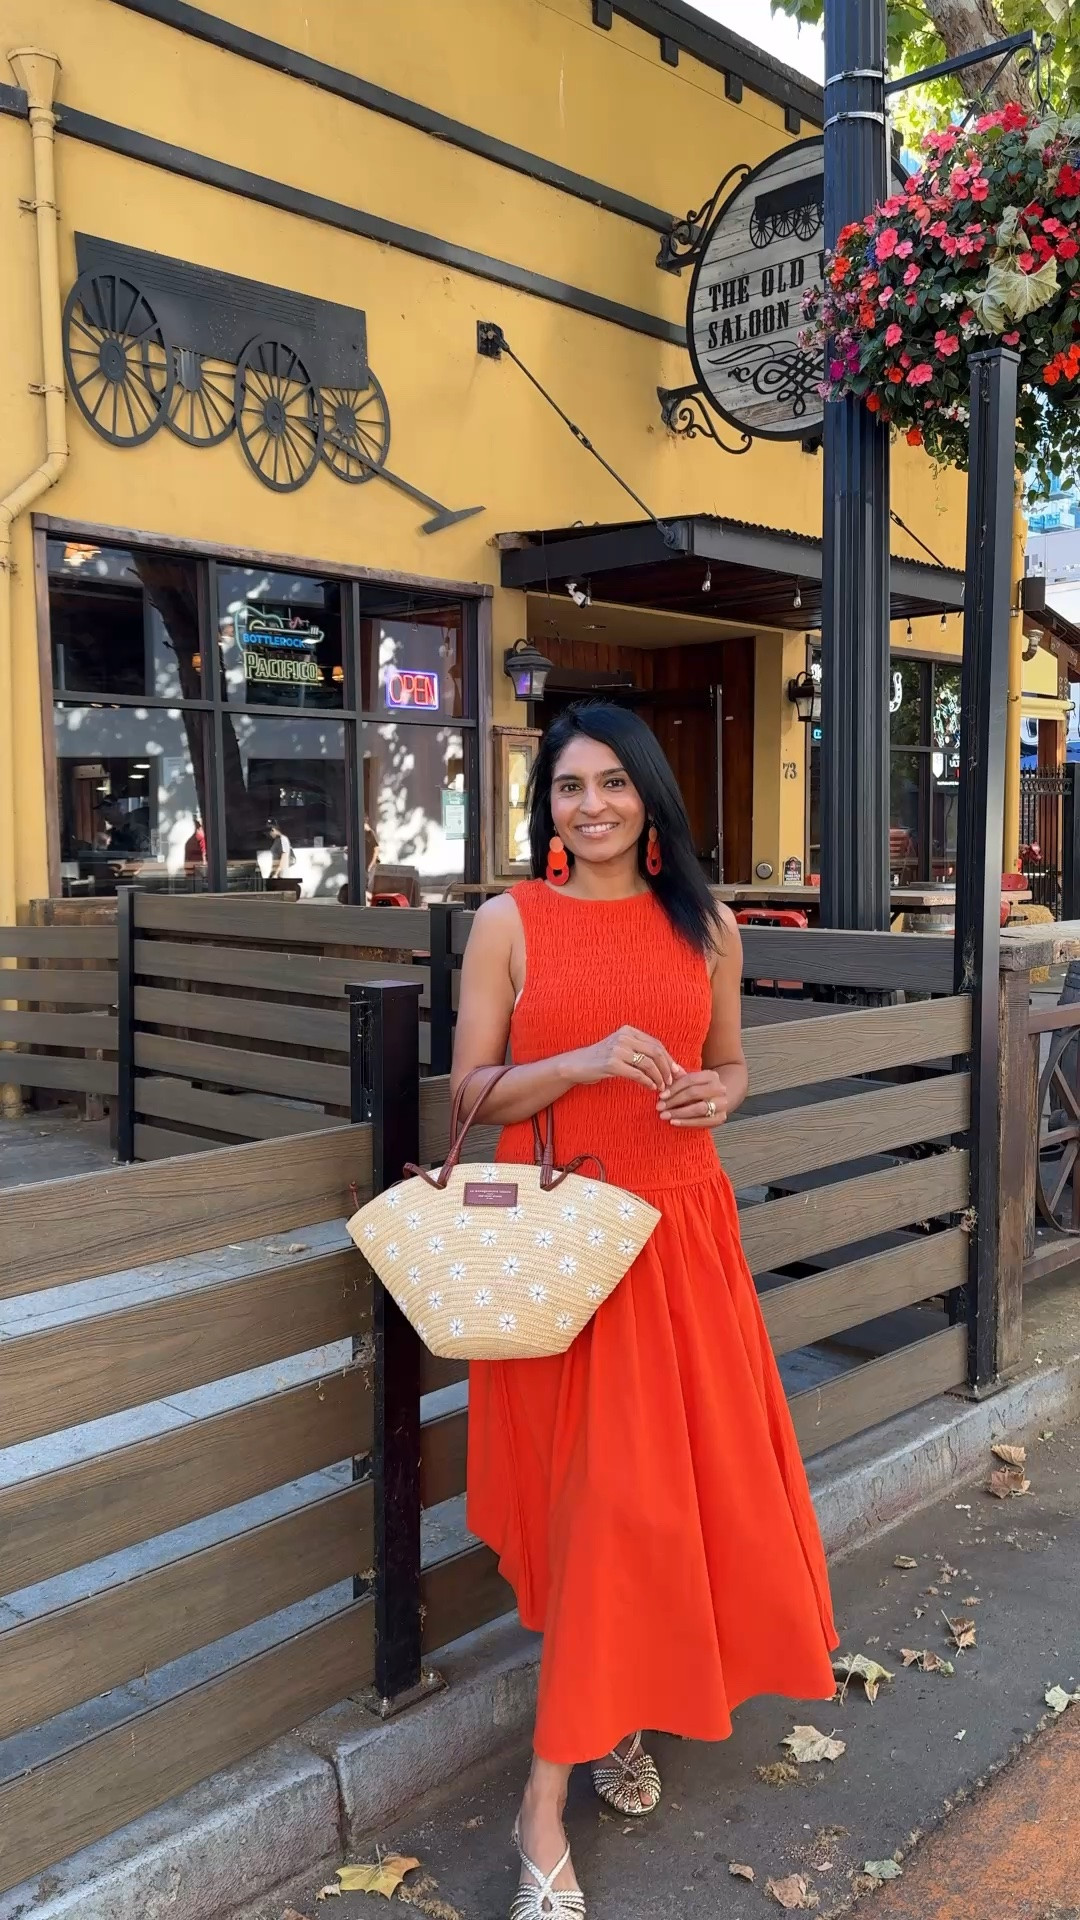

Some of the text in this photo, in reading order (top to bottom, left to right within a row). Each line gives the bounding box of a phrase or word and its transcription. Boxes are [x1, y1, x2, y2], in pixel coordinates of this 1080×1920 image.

[708, 275, 750, 313] THE
[761, 258, 805, 298] OLD
[708, 299, 790, 349] SALOON
[242, 633, 306, 649] BOTTLEROCK
[389, 674, 437, 706] OPEN
[782, 762, 798, 780] 73
